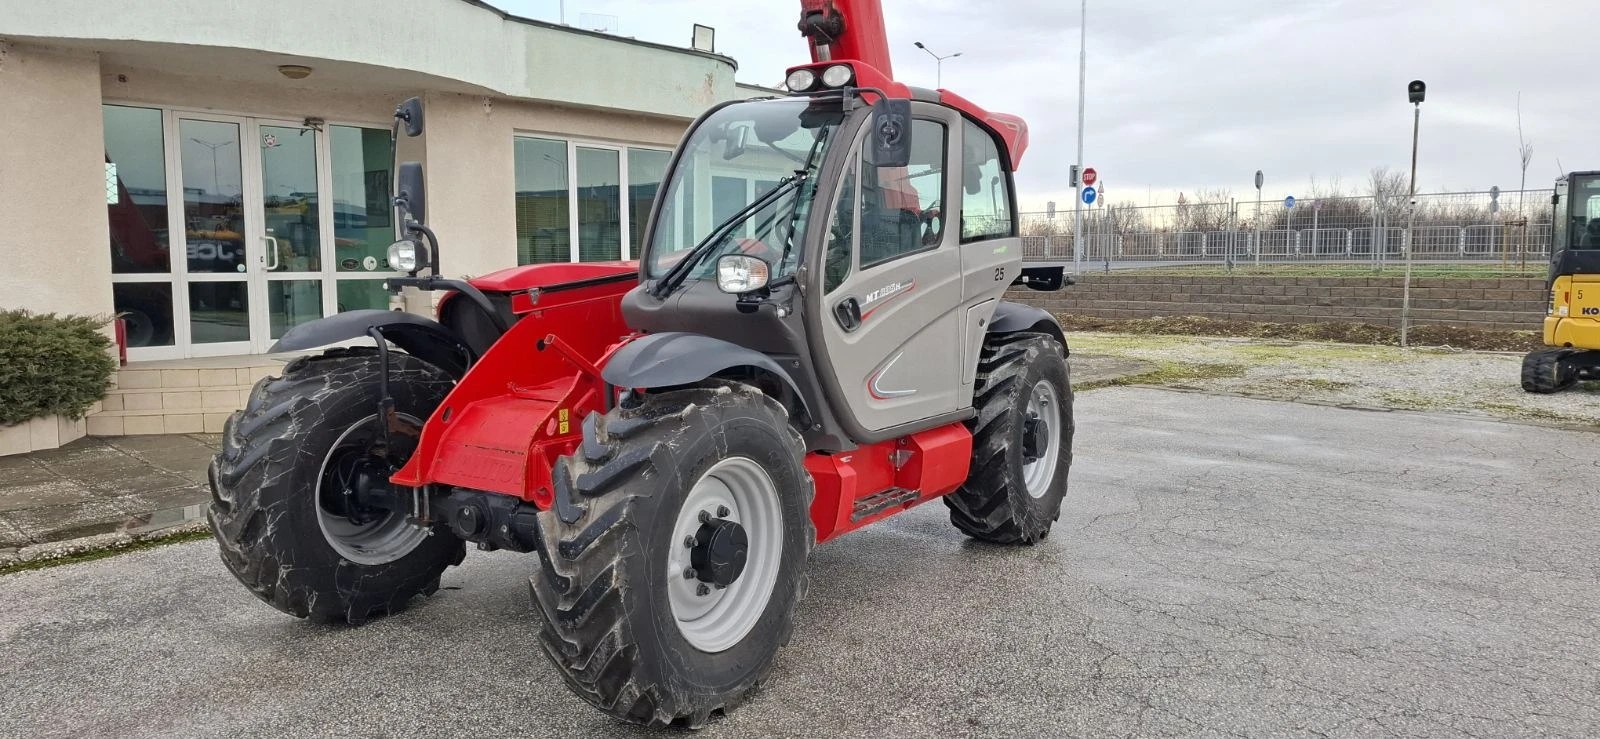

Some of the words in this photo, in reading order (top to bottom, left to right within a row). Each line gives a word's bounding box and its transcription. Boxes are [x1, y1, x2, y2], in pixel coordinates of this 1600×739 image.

[1083, 173, 1095, 181] STOP
[994, 267, 1005, 281] 25
[866, 290, 880, 304] MT
[1577, 290, 1583, 299] 5
